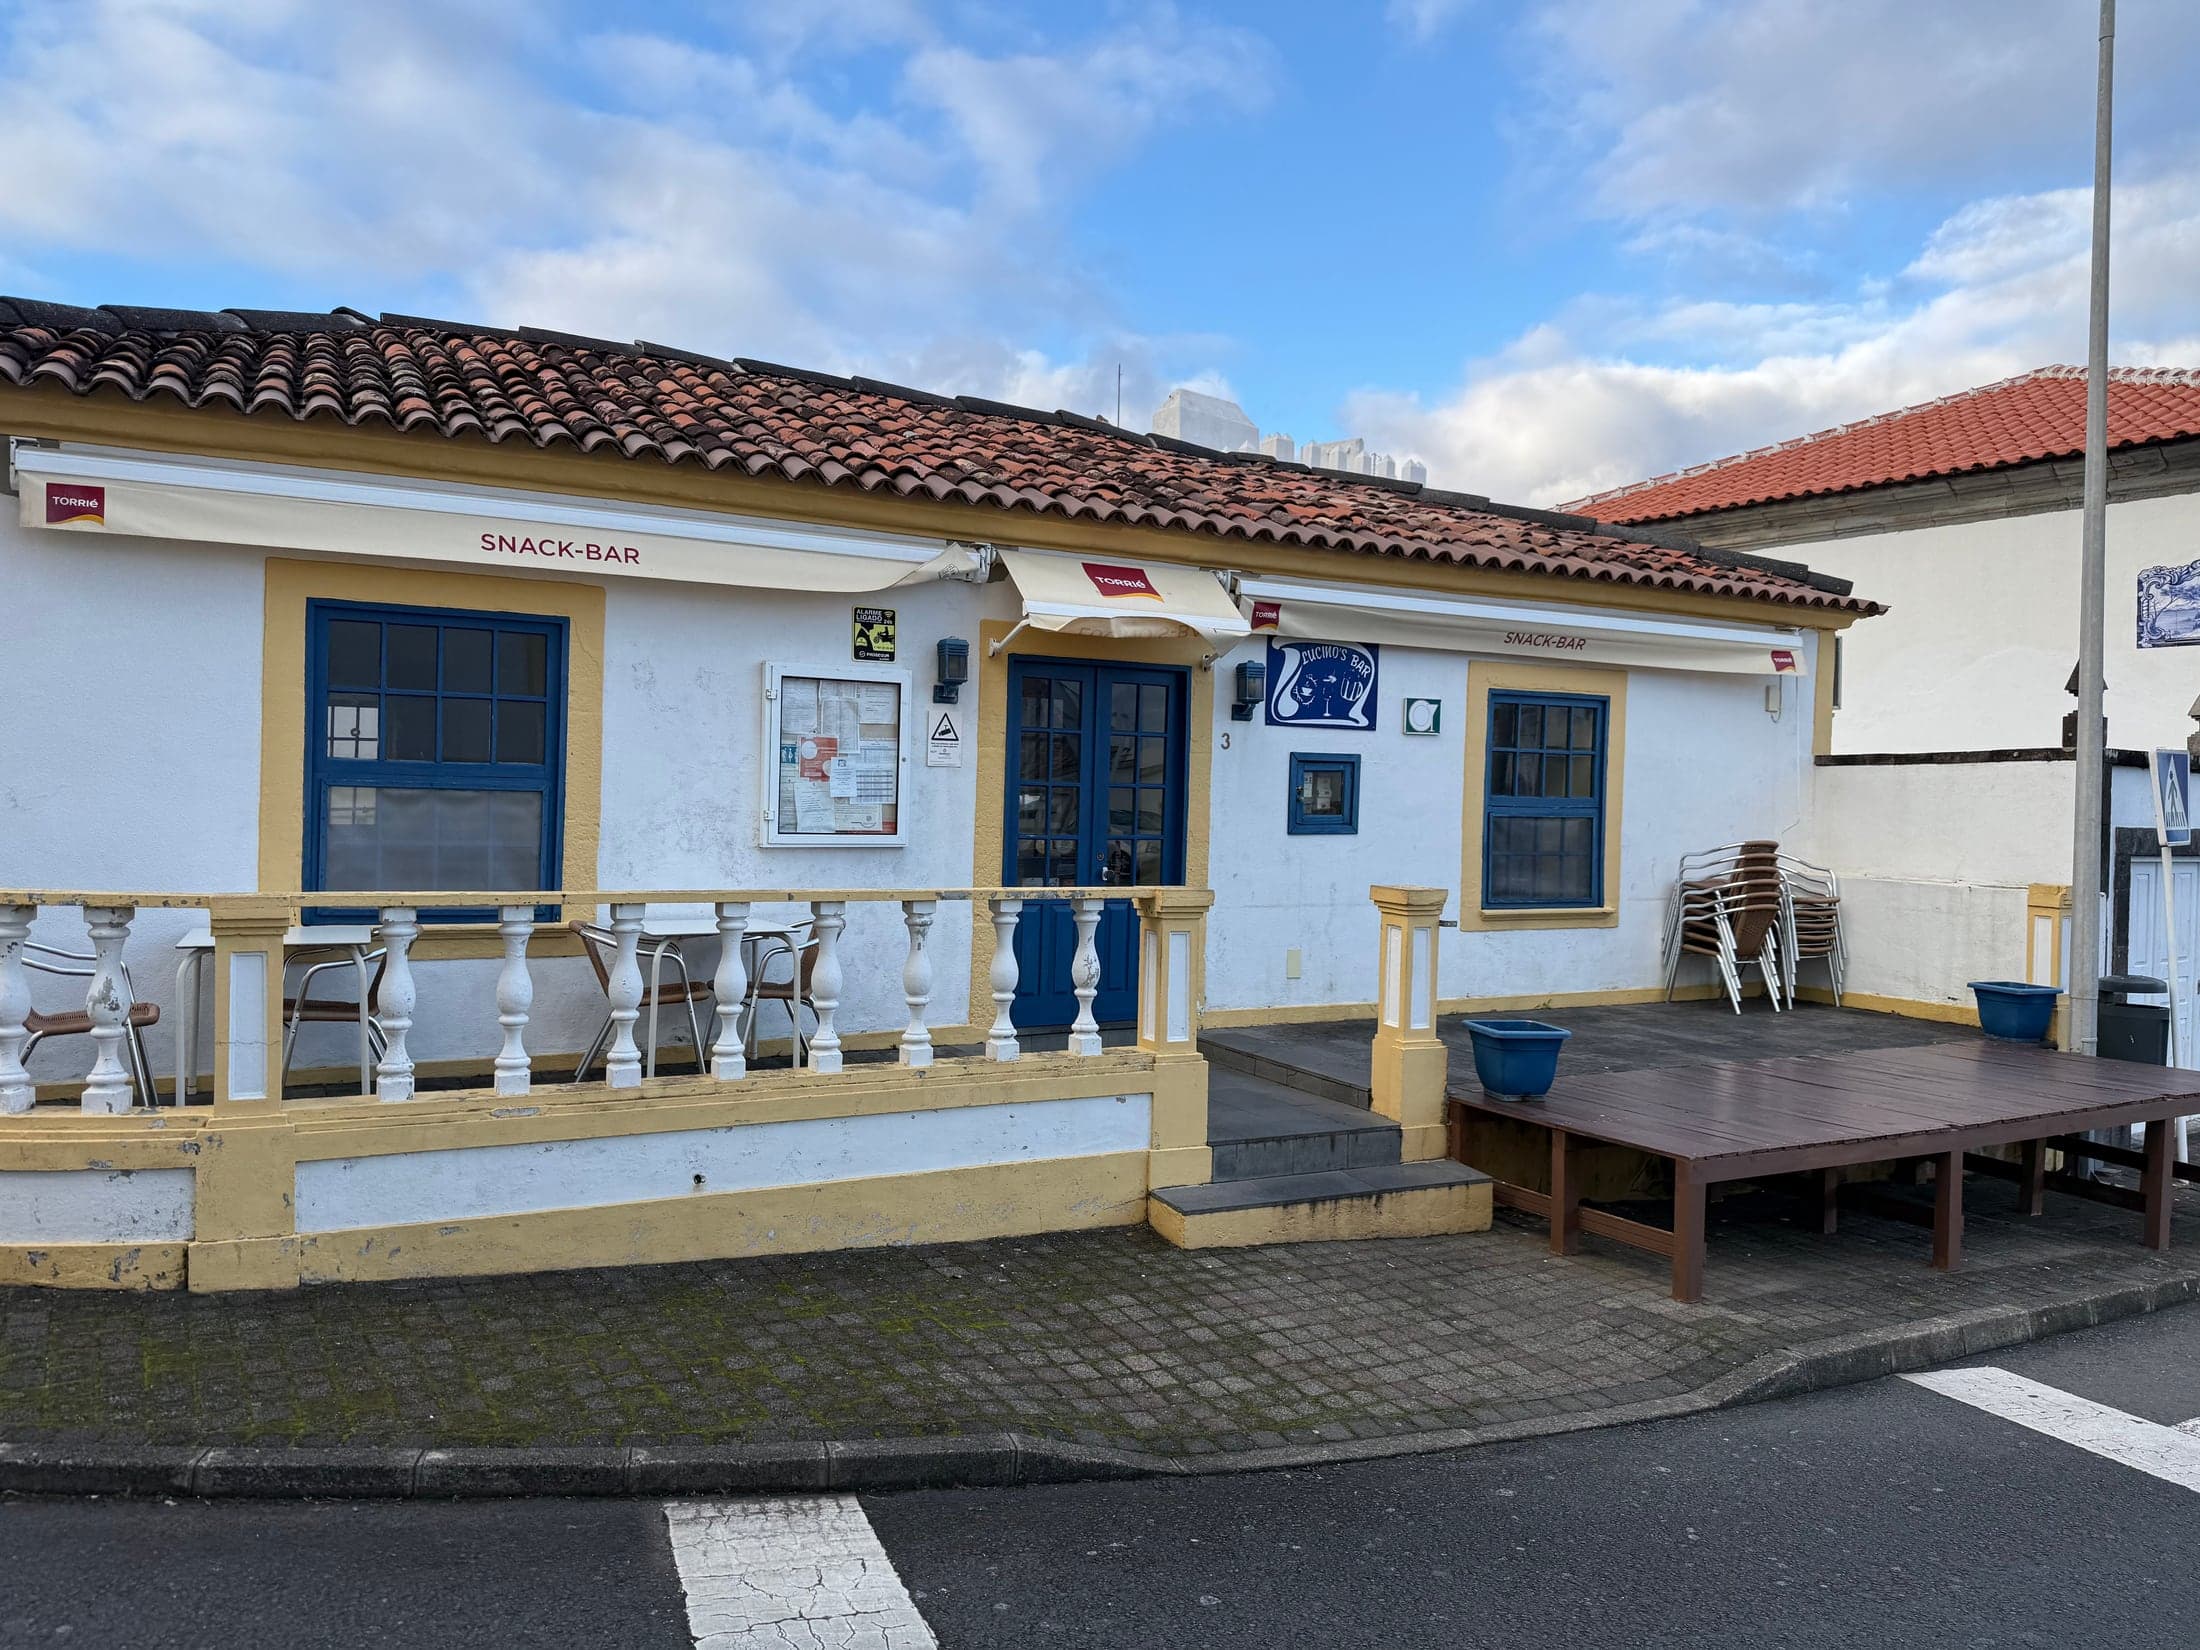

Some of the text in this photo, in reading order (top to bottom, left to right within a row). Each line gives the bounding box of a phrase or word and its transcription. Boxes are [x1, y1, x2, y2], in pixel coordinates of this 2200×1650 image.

[480, 533, 640, 565] SNACK-BAR
[1503, 631, 1587, 651] SNACK-BAR
[1350, 654, 1371, 678] BAR
[1220, 732, 1231, 750] 3
